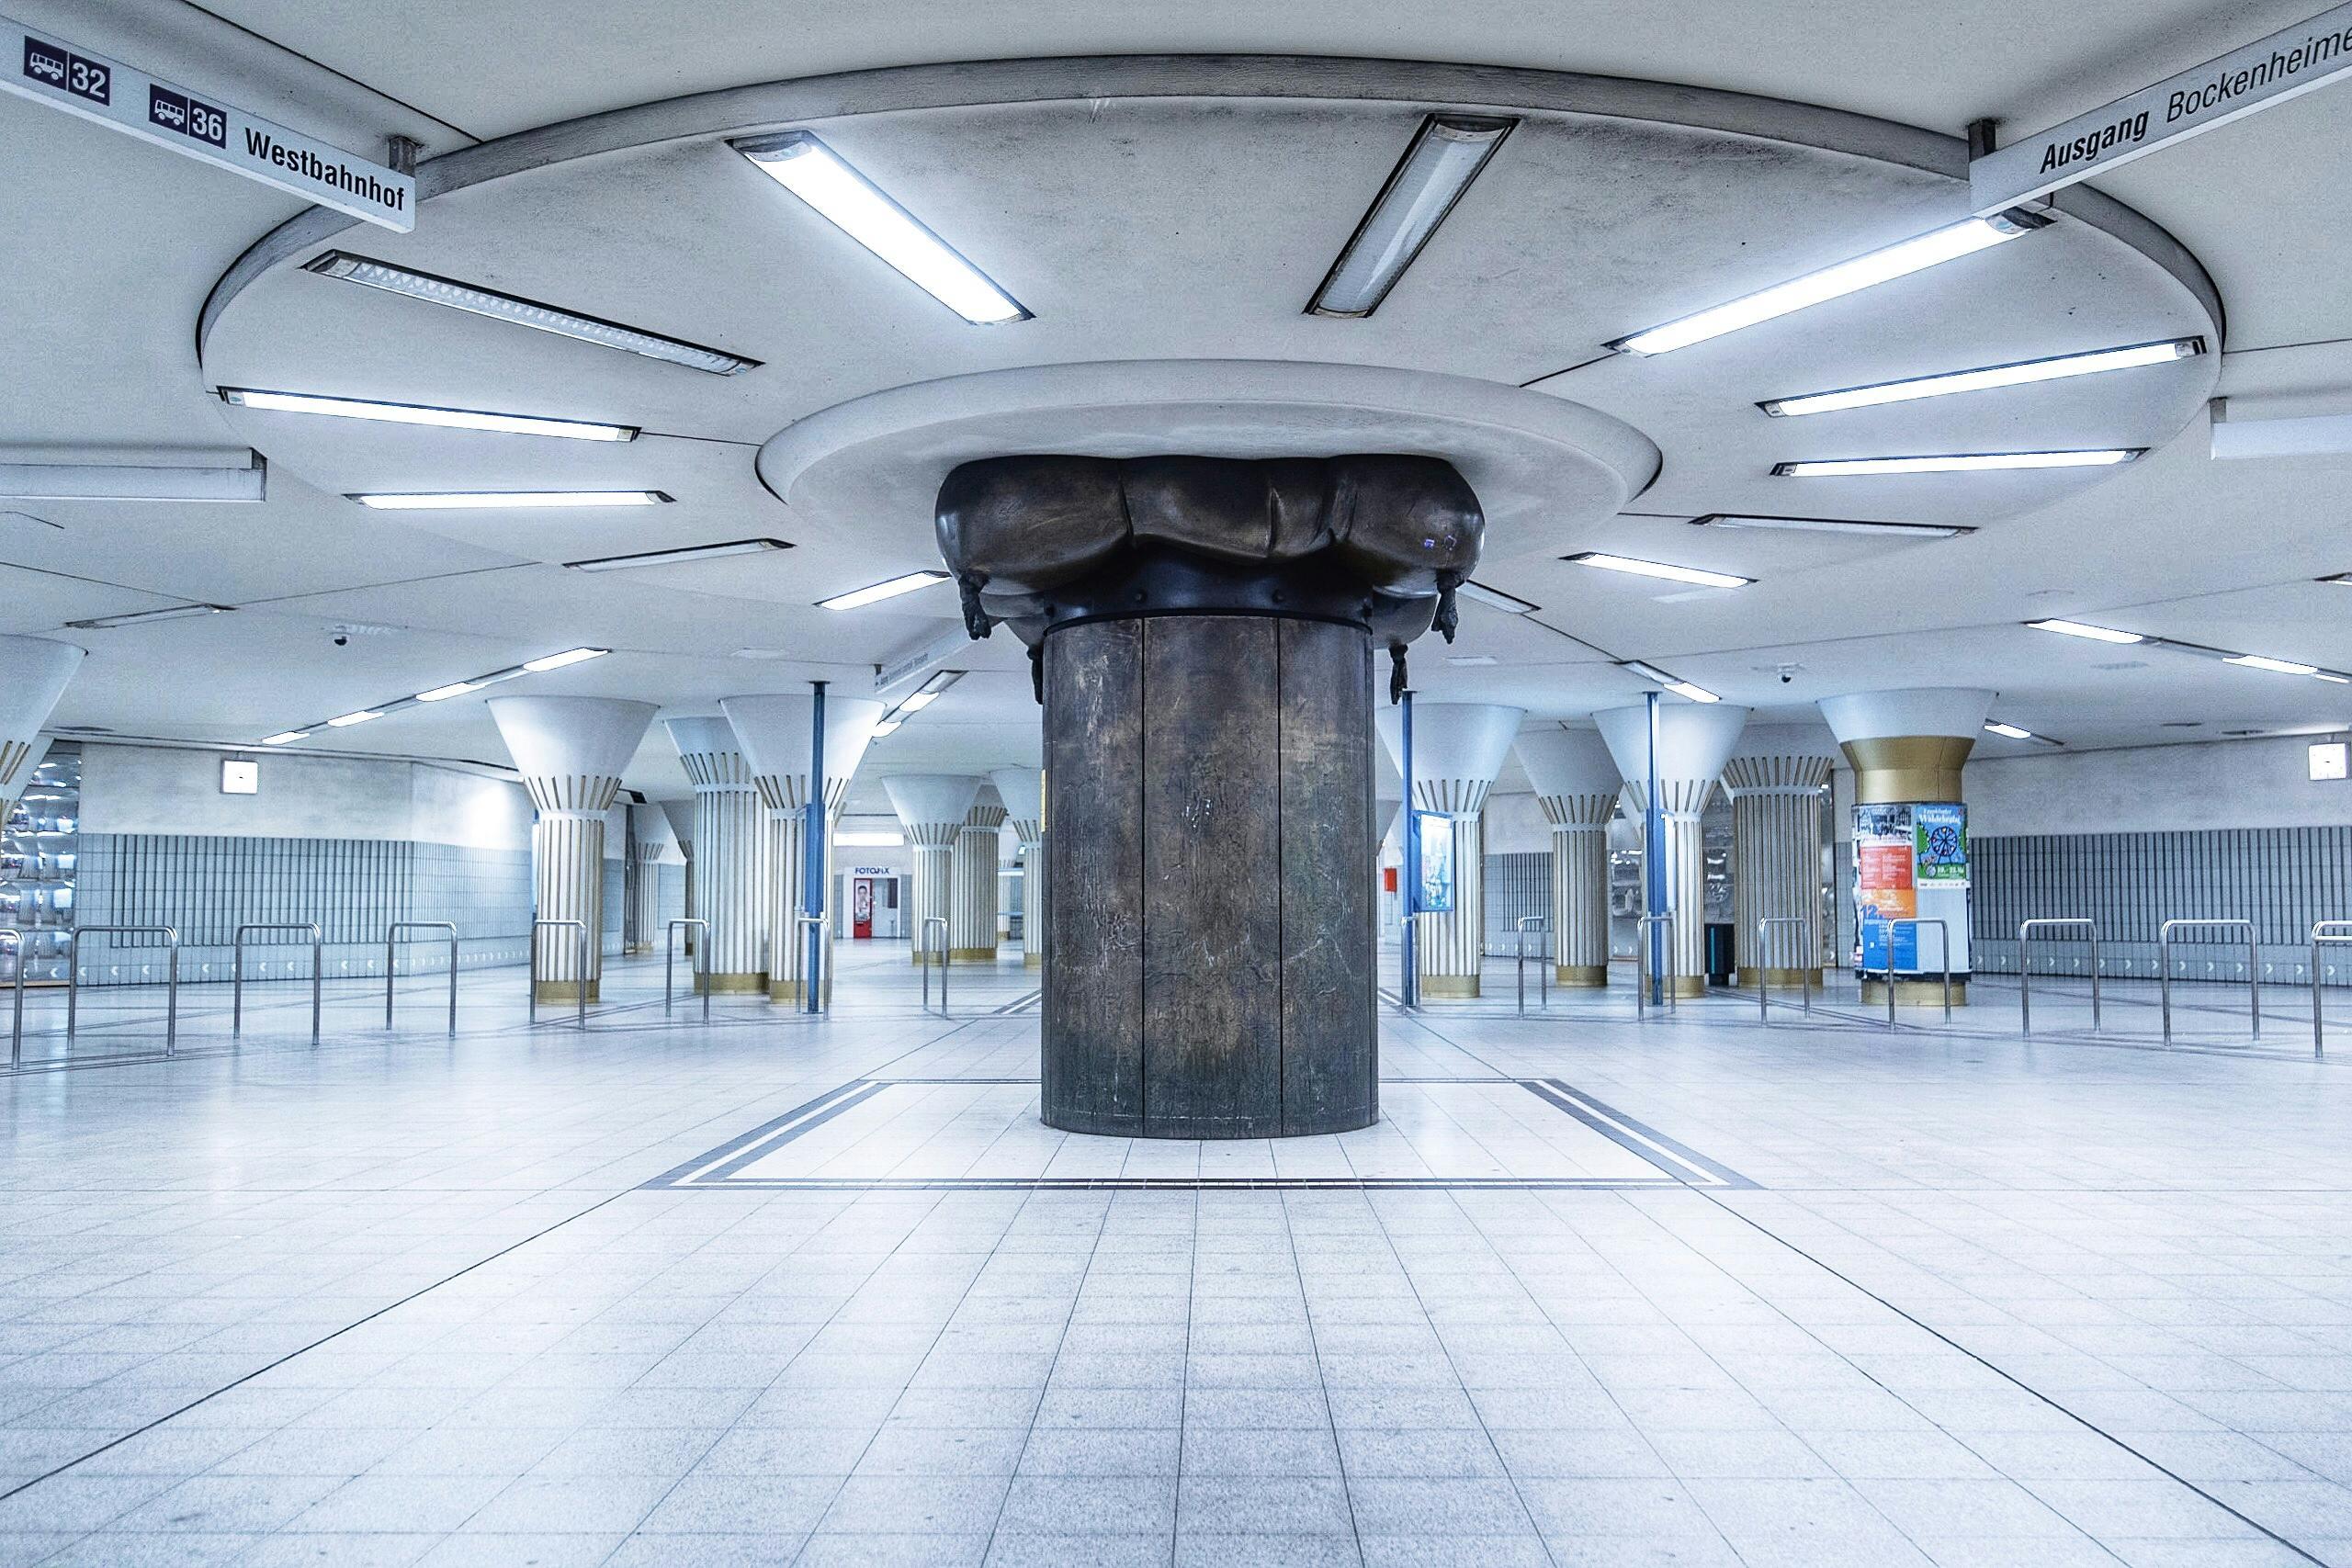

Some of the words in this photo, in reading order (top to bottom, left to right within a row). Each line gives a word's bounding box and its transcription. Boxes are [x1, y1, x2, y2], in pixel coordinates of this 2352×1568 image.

[72, 62, 106, 98] 32
[192, 107, 223, 141] 36
[244, 128, 404, 211] Westbahnhof
[2039, 110, 2150, 174] Ausgang
